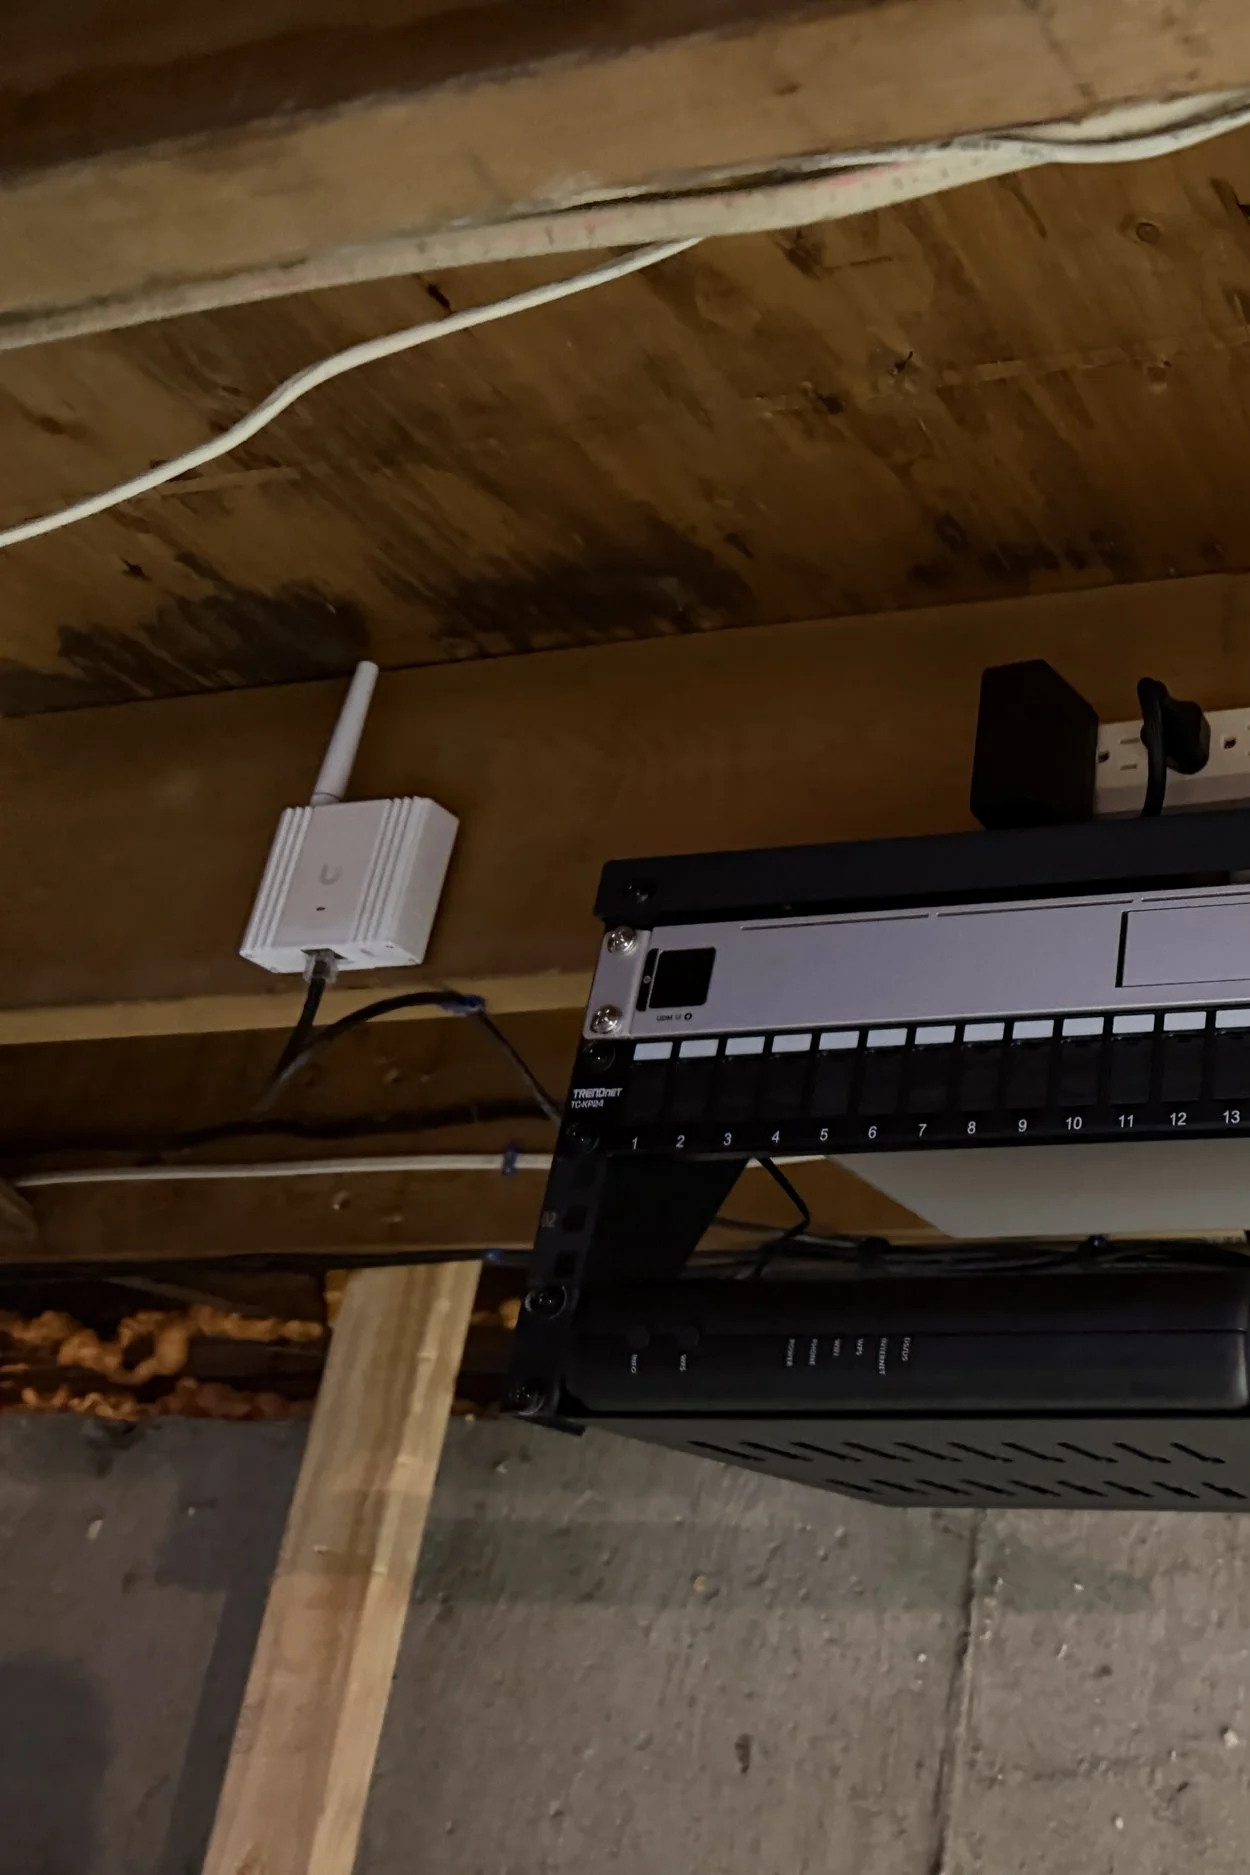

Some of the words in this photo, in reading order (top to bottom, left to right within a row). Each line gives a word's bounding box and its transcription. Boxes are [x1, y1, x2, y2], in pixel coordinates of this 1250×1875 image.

[632, 1137, 638, 1149] 1
[676, 1135, 685, 1148] 2
[723, 1132, 732, 1146] 3
[771, 1130, 780, 1143] 4
[819, 1128, 829, 1141] 5
[868, 1125, 877, 1139] 6
[919, 1123, 927, 1137] 7
[967, 1121, 976, 1135] 8
[1018, 1119, 1028, 1133] 9
[1066, 1116, 1083, 1130] 10
[1118, 1114, 1134, 1128] 11
[1170, 1112, 1187, 1126] 12
[1223, 1110, 1241, 1124] 13
